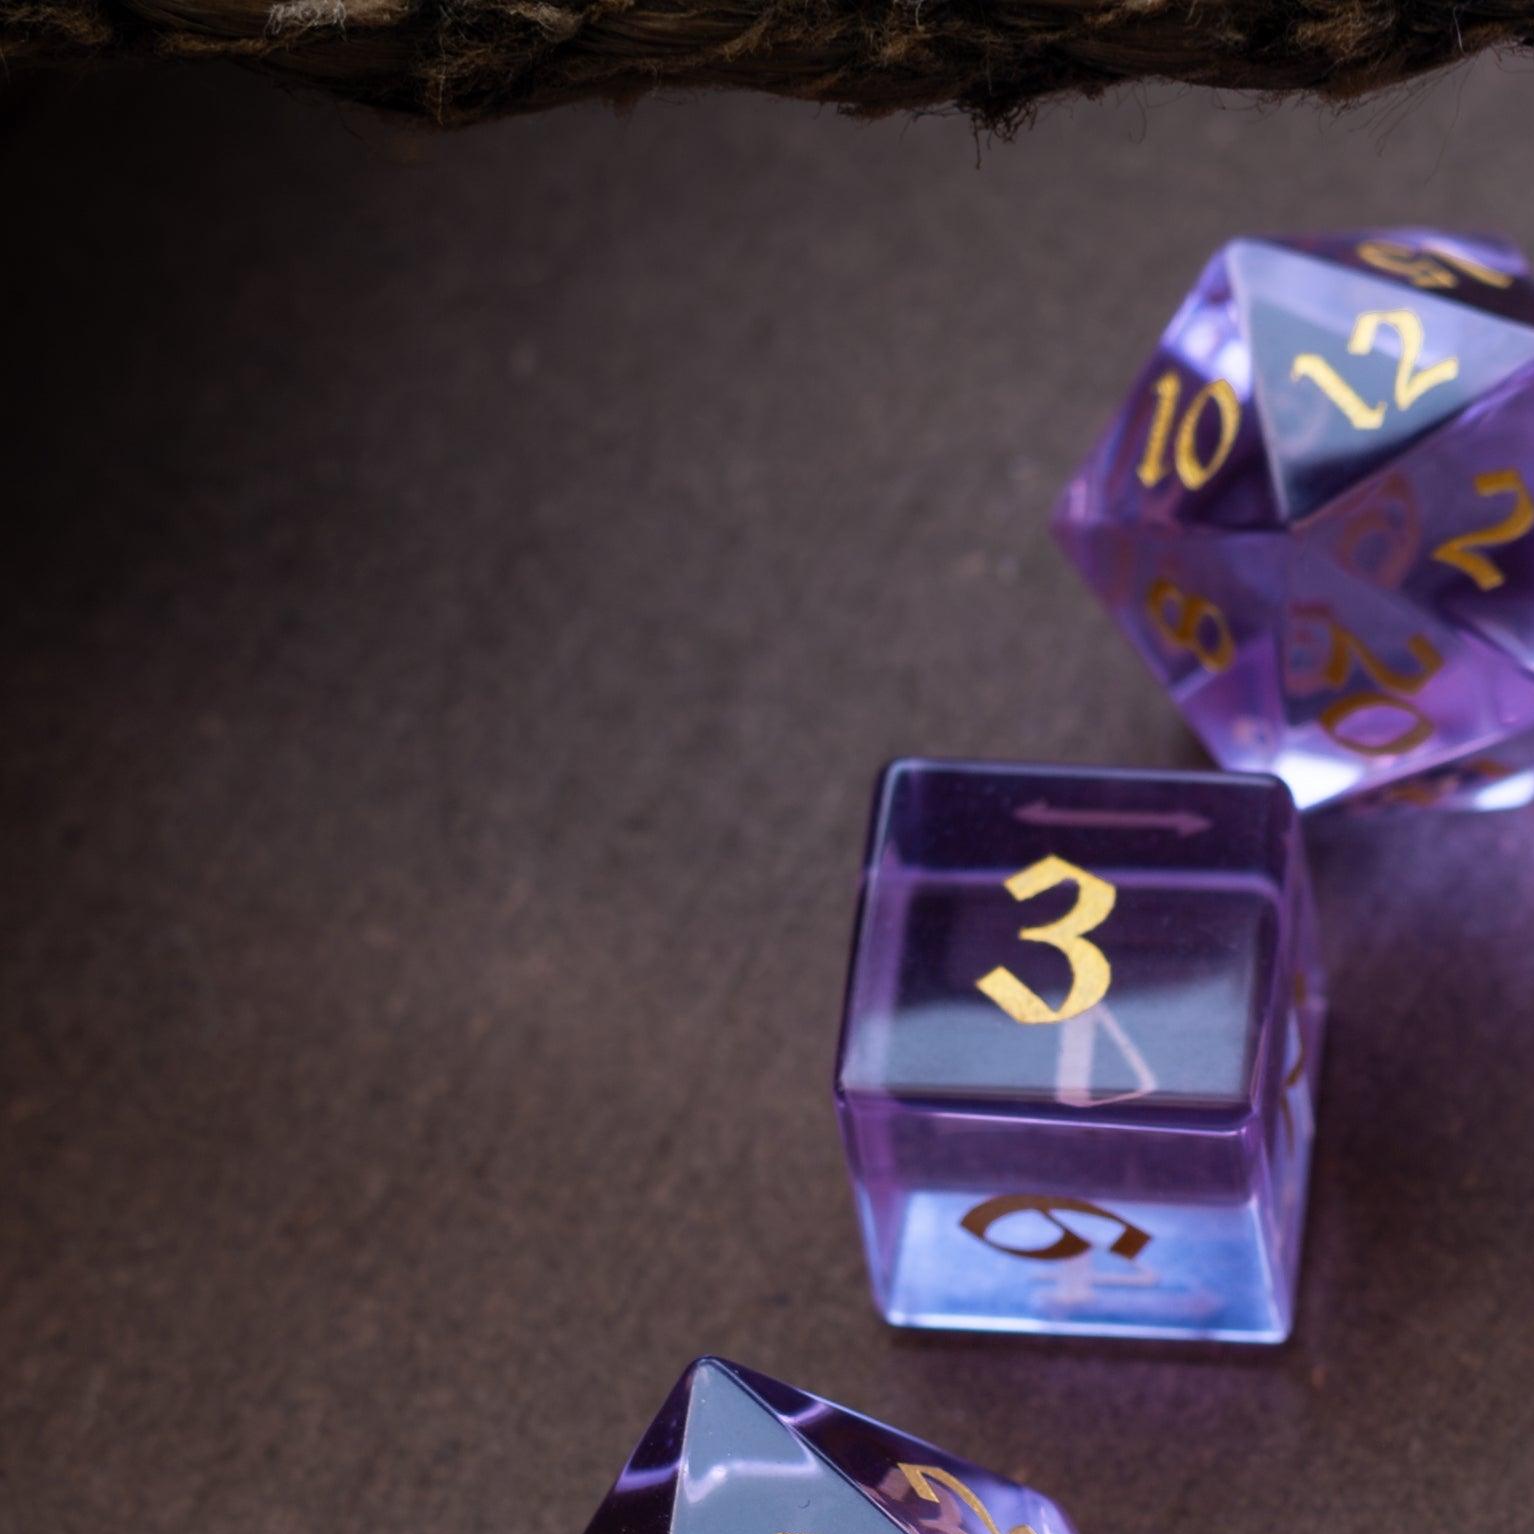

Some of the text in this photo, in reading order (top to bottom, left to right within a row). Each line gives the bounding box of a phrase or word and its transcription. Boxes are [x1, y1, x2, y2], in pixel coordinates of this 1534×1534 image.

[1290, 309, 1458, 429] 12
[1136, 371, 1241, 491] 10
[1146, 577, 1237, 673] 8
[975, 854, 1117, 1025] 3
